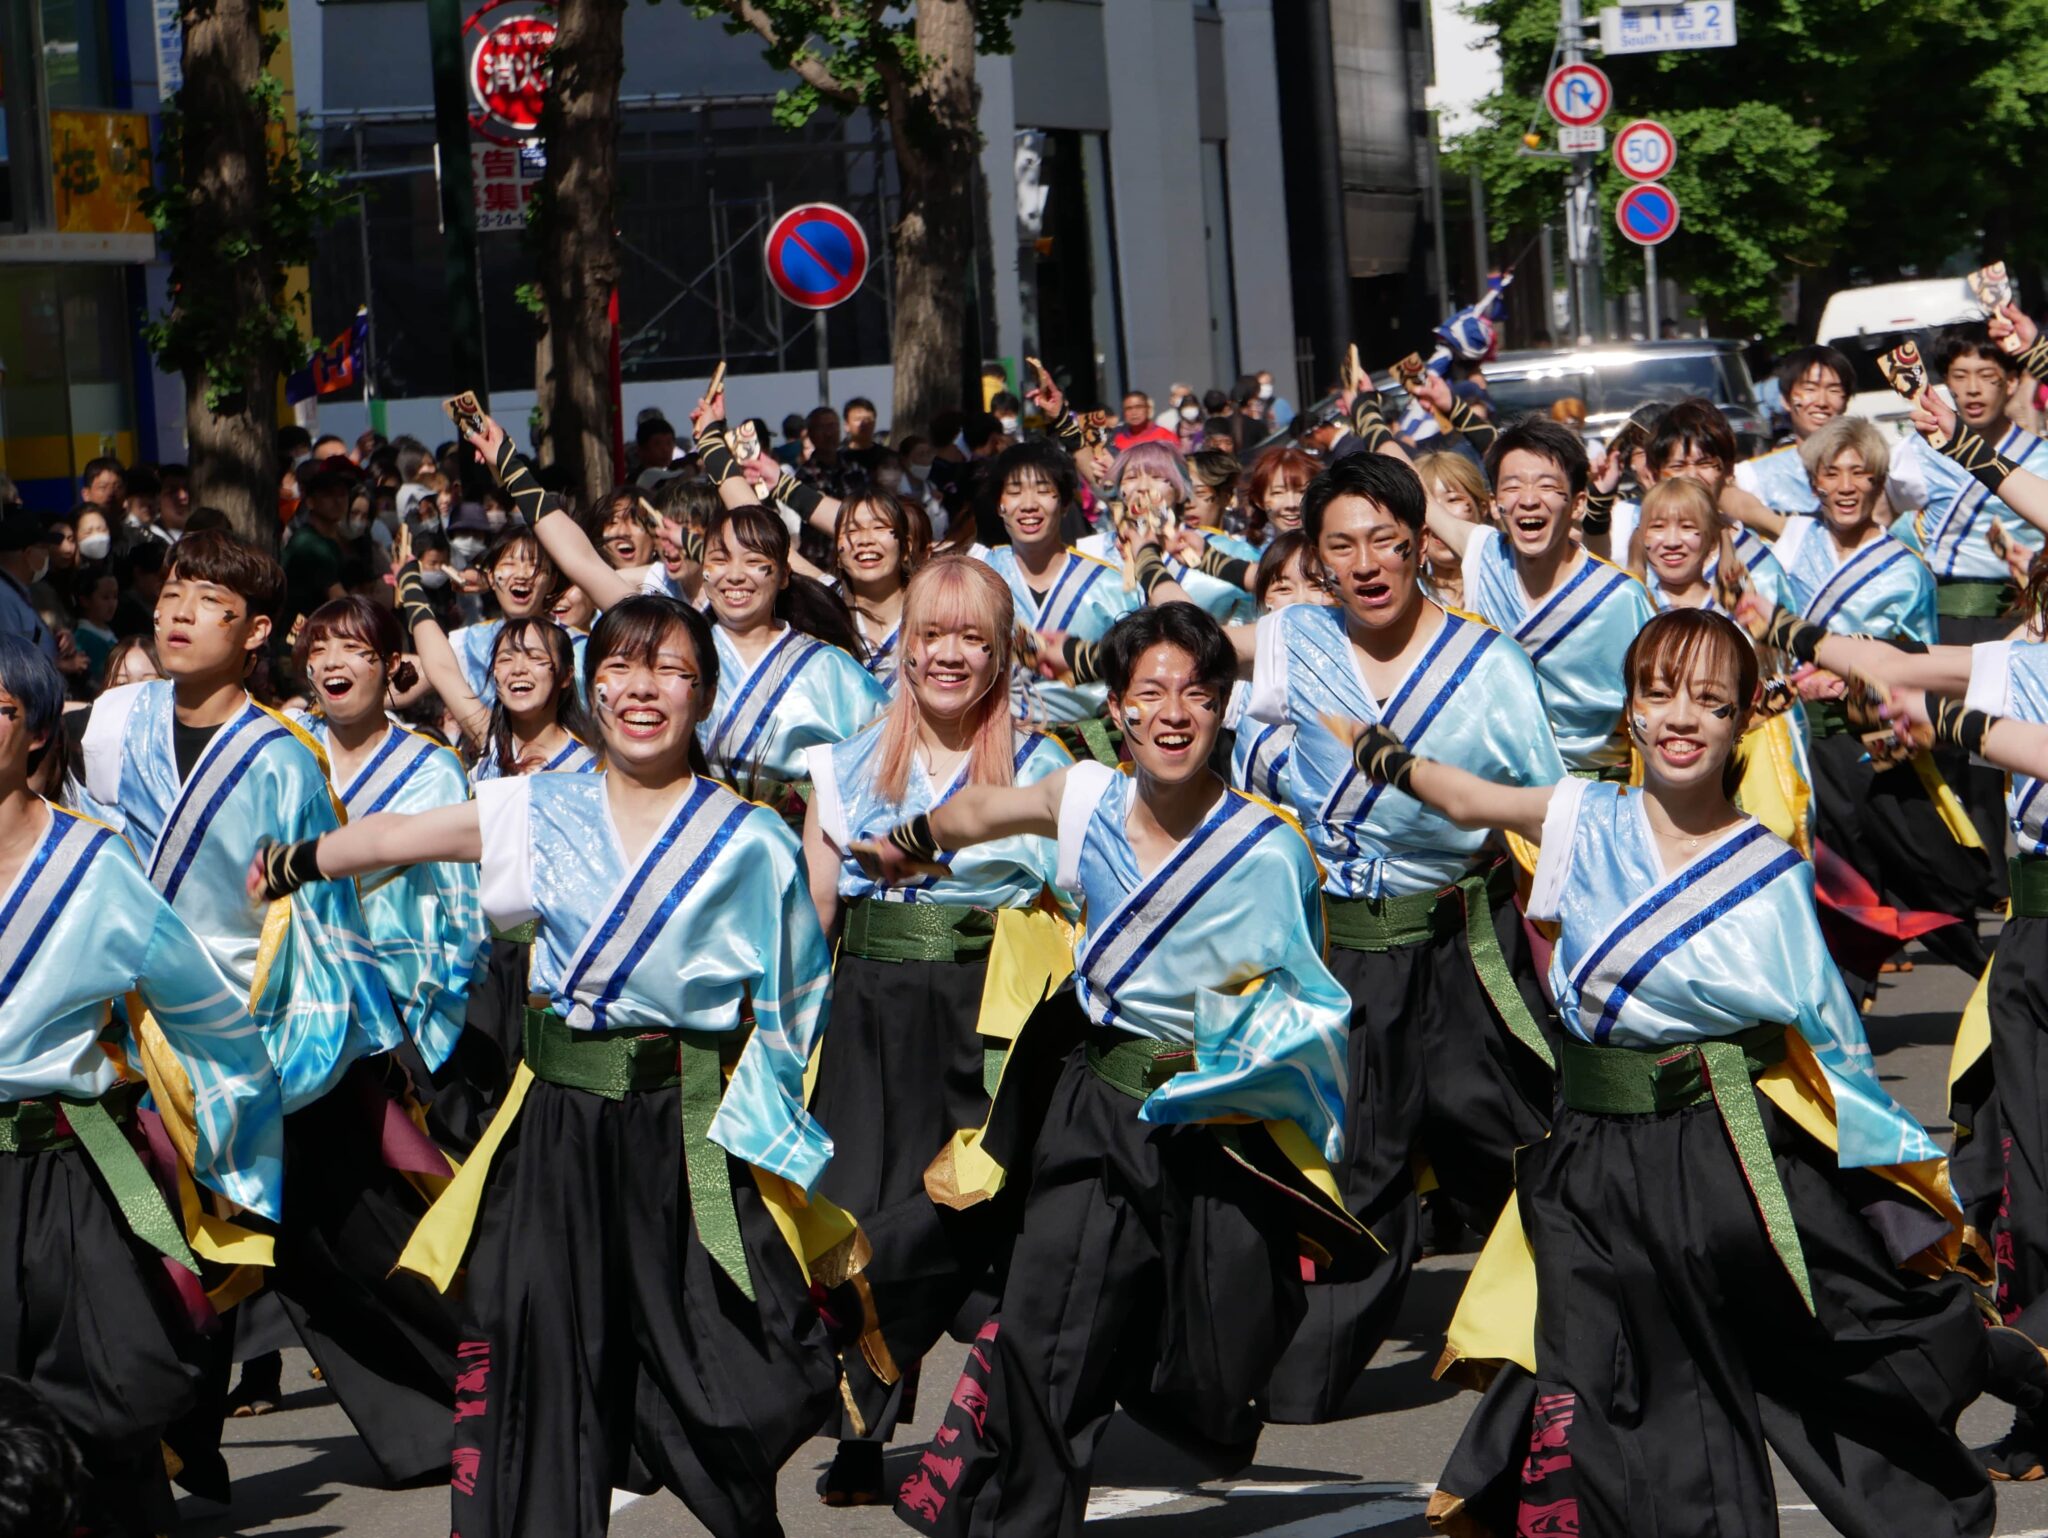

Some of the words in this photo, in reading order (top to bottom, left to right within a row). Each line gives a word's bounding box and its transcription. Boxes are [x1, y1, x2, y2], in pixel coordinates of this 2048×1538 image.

[1621, 33, 1657, 47] South
[1677, 30, 1706, 41] West
[471, 149, 517, 179] 告
[1627, 138, 1661, 164] 50
